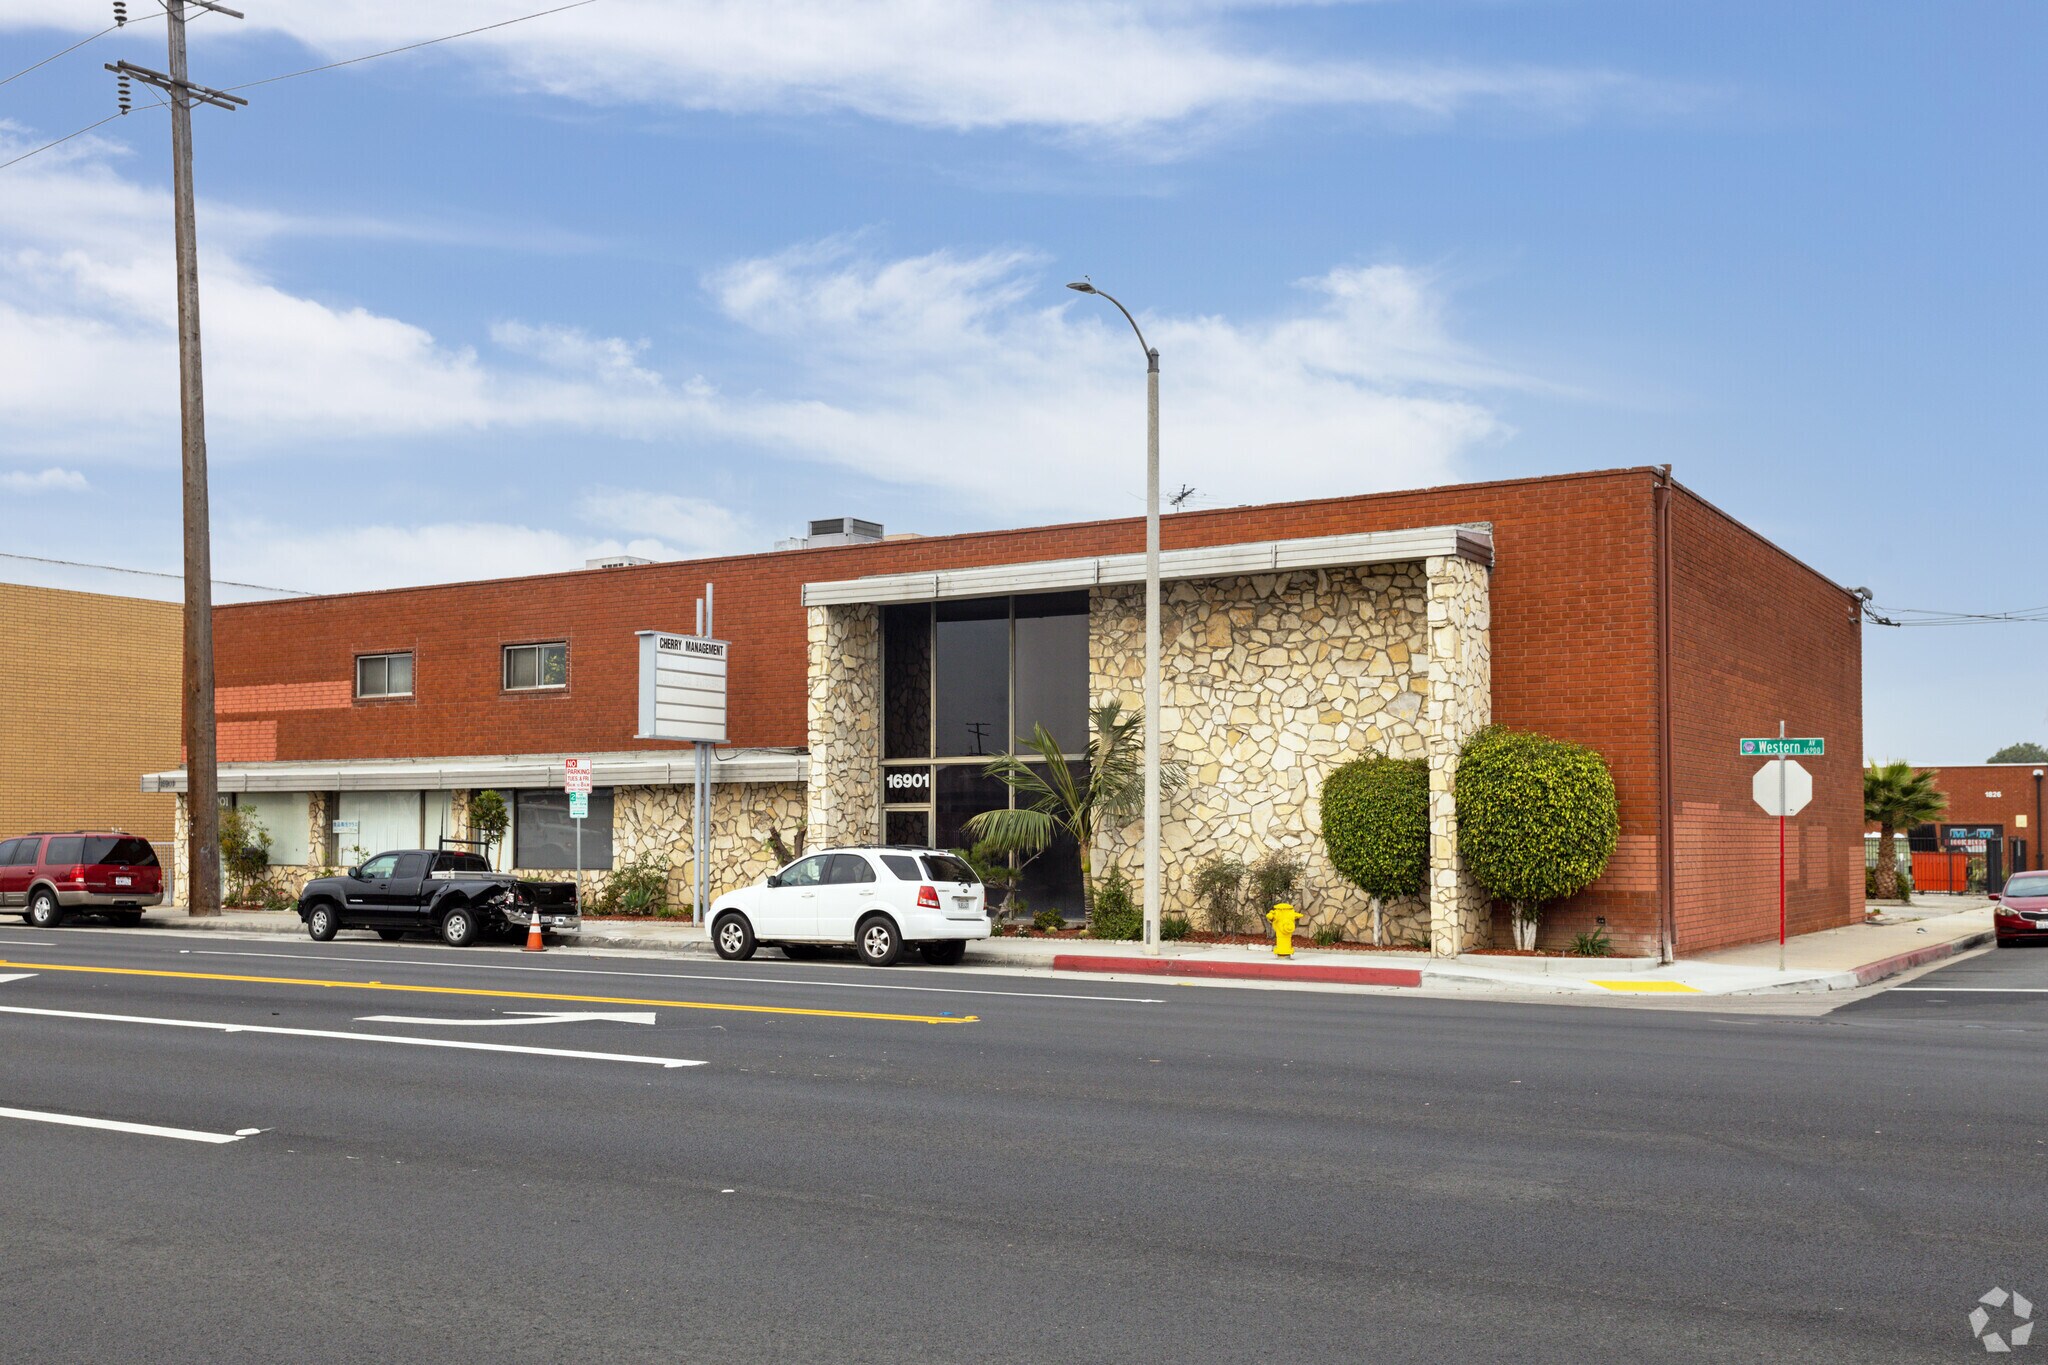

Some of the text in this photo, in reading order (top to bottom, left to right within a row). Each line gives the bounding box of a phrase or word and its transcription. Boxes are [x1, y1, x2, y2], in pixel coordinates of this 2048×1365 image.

[660, 637, 723, 656] CHERRY MANAGEMENT
[1758, 741, 1801, 753] Western
[886, 773, 930, 789] 16901
[1952, 830, 1965, 838] M
